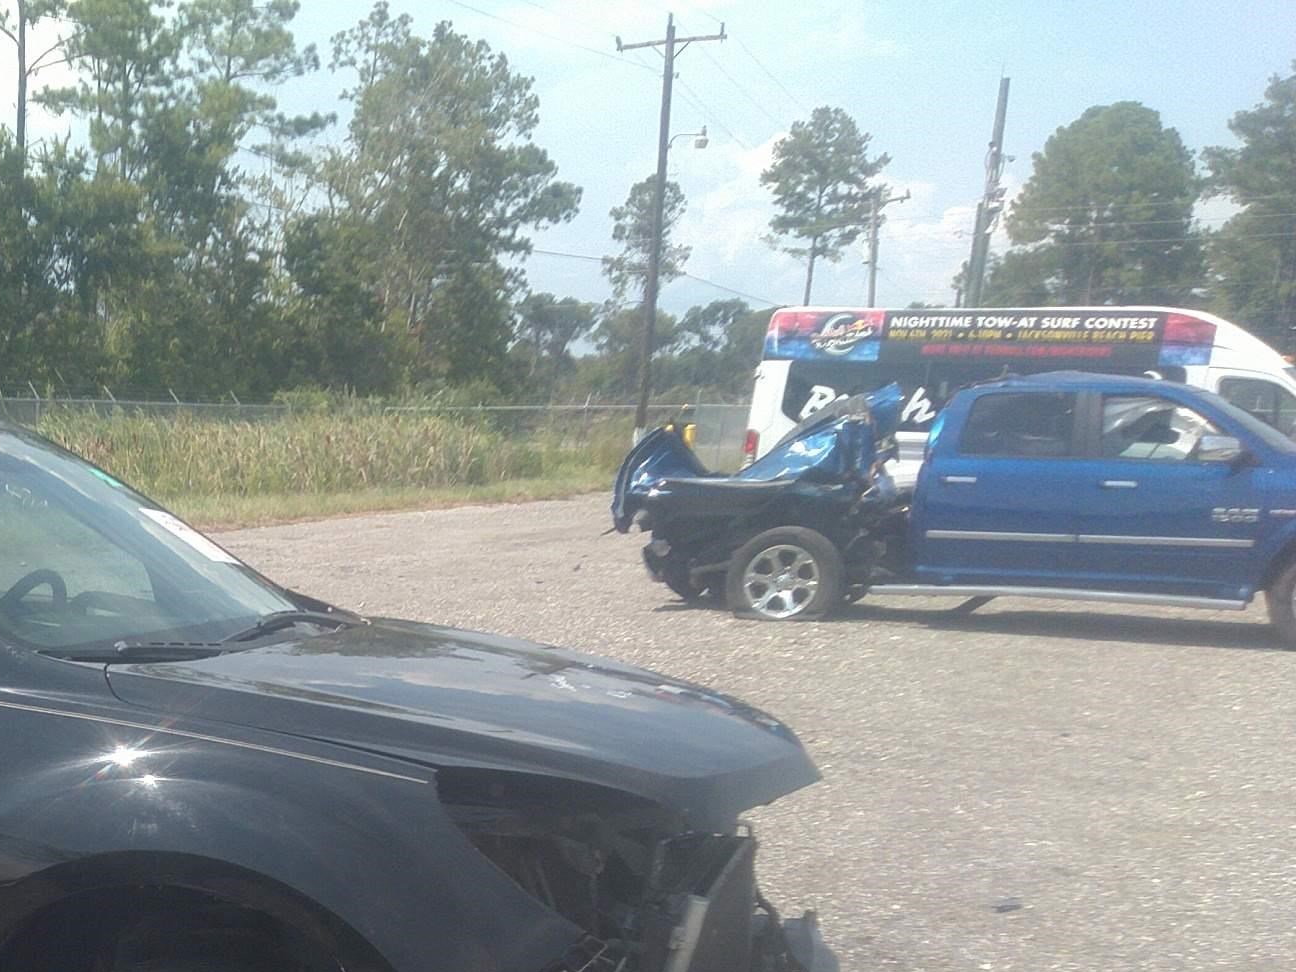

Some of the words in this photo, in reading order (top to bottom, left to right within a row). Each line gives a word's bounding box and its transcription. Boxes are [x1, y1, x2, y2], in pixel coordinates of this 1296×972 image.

[890, 315, 973, 328] NIGHTTIME
[976, 316, 1038, 330] TOW-AT
[1040, 316, 1081, 330] SURF
[1084, 316, 1158, 331] CONTEST
[1091, 330, 1127, 342] BEACH
